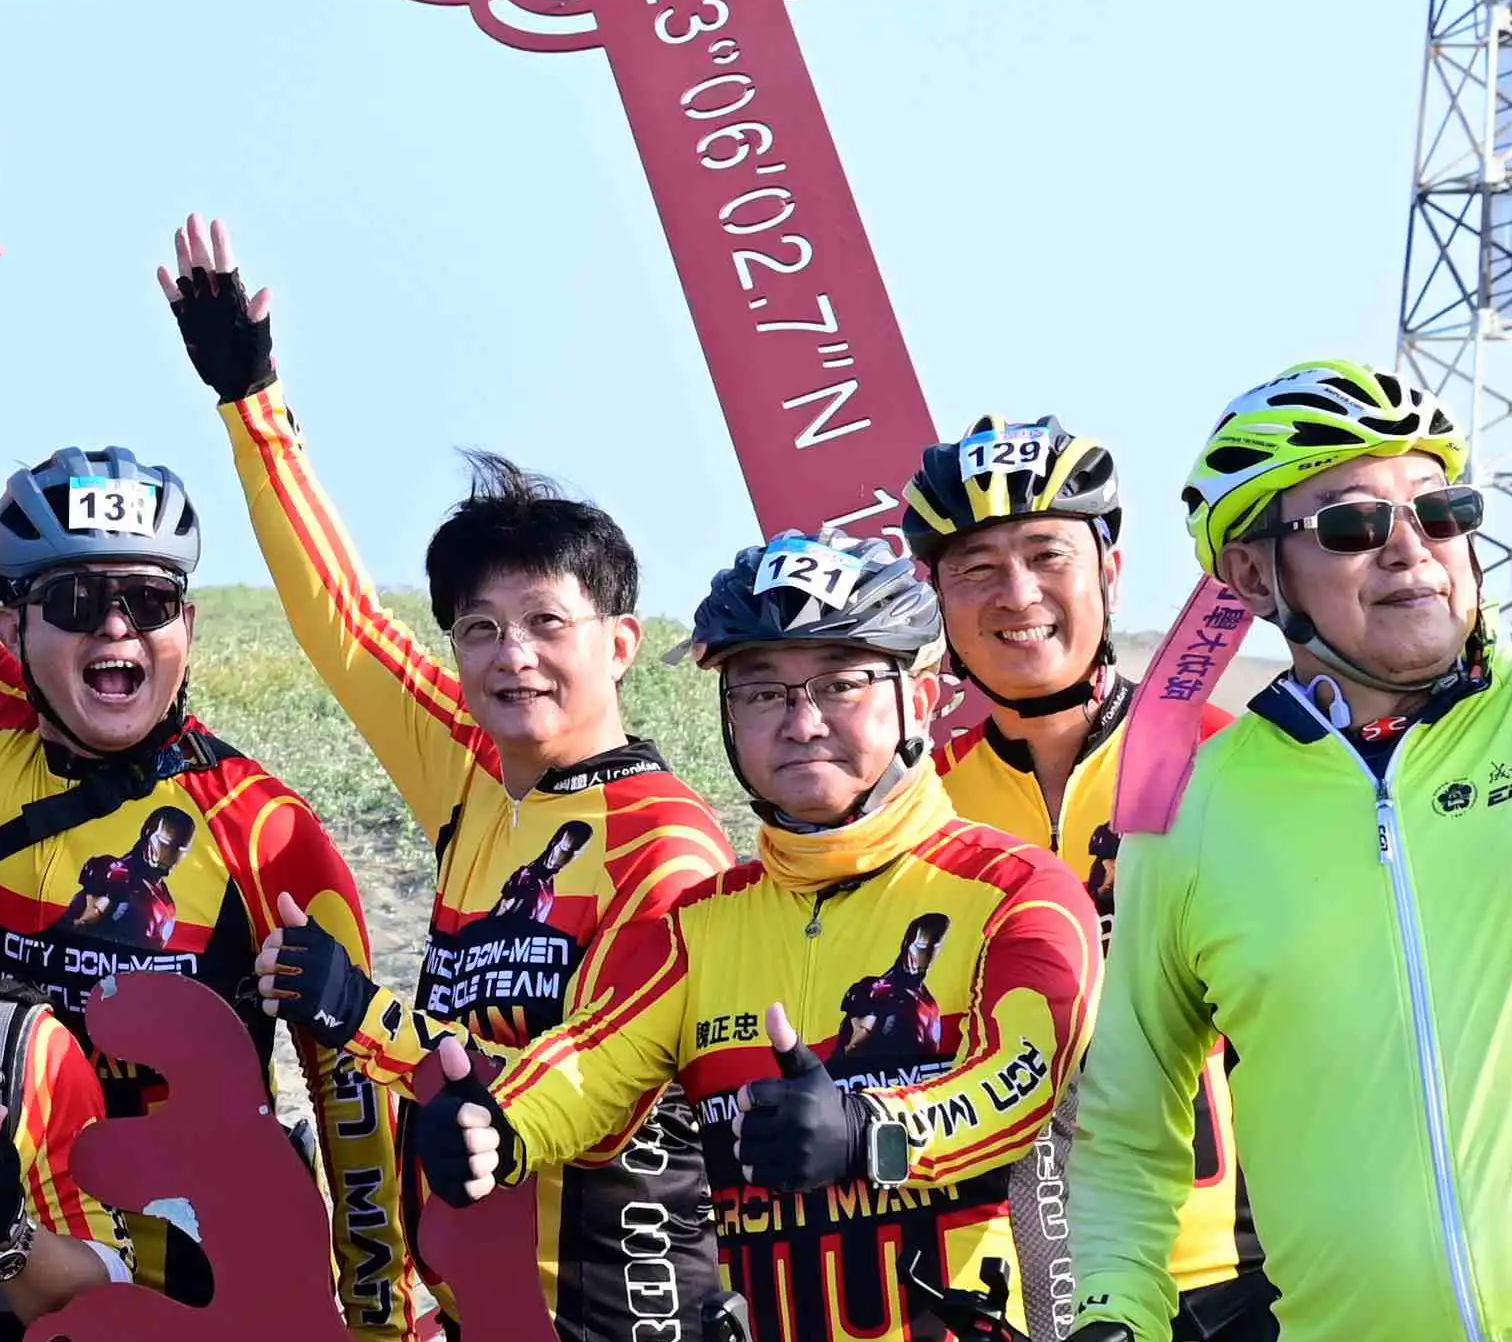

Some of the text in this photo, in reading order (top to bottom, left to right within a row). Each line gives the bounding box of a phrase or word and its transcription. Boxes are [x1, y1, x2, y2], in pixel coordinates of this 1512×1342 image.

[967, 441, 1041, 467] 129
[768, 554, 843, 594] 121
[4, 931, 56, 968] CITY
[64, 946, 199, 977] DON-MEN
[465, 936, 569, 973] DON-MEN
[484, 970, 561, 1000] TEAM
